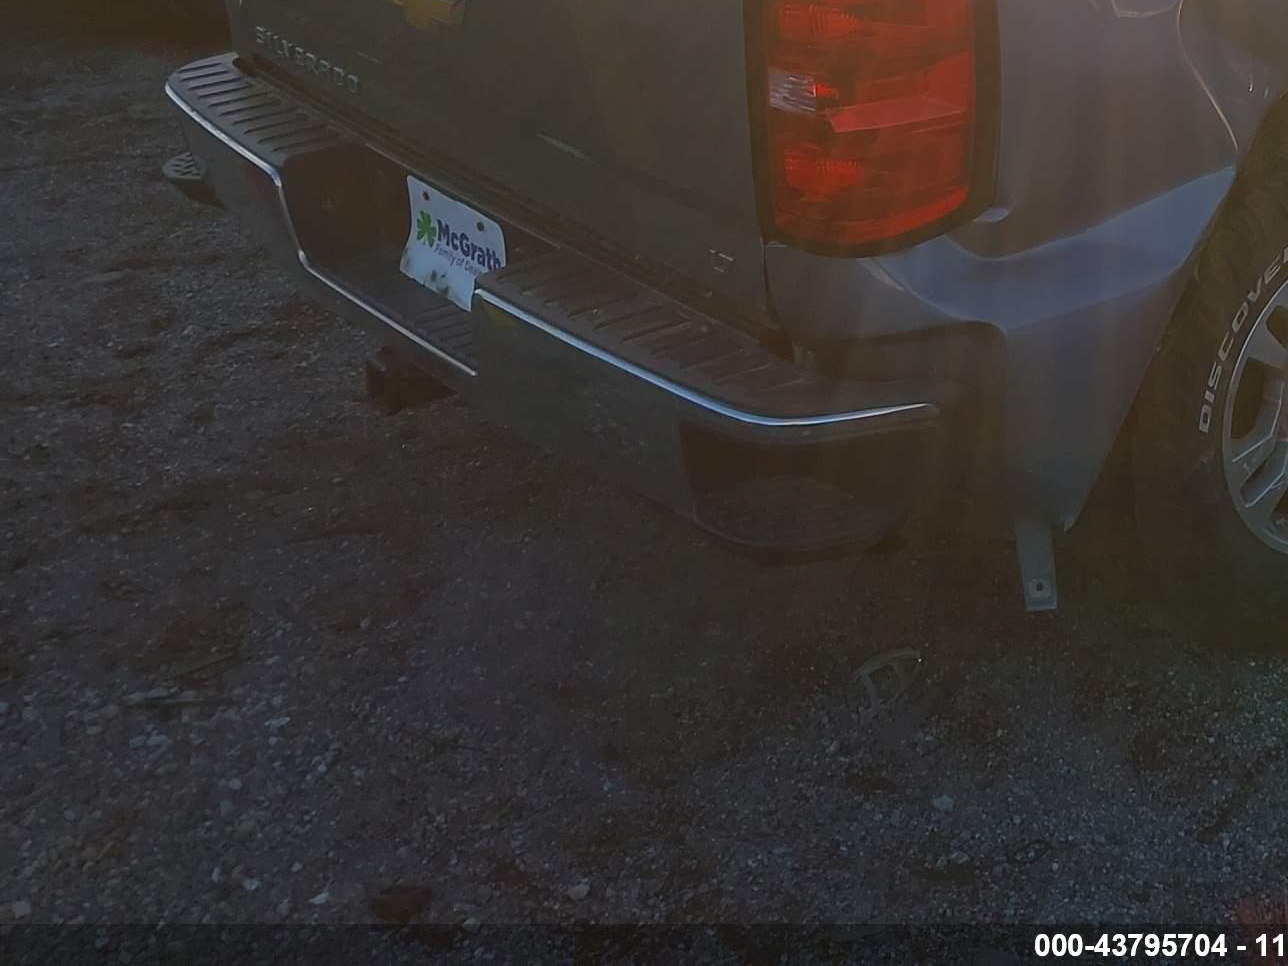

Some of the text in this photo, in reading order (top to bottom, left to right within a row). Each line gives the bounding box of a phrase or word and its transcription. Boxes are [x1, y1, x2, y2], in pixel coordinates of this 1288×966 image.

[255, 25, 359, 93] SILVERADO
[434, 243, 456, 266] Family
[437, 219, 502, 271] McGrath
